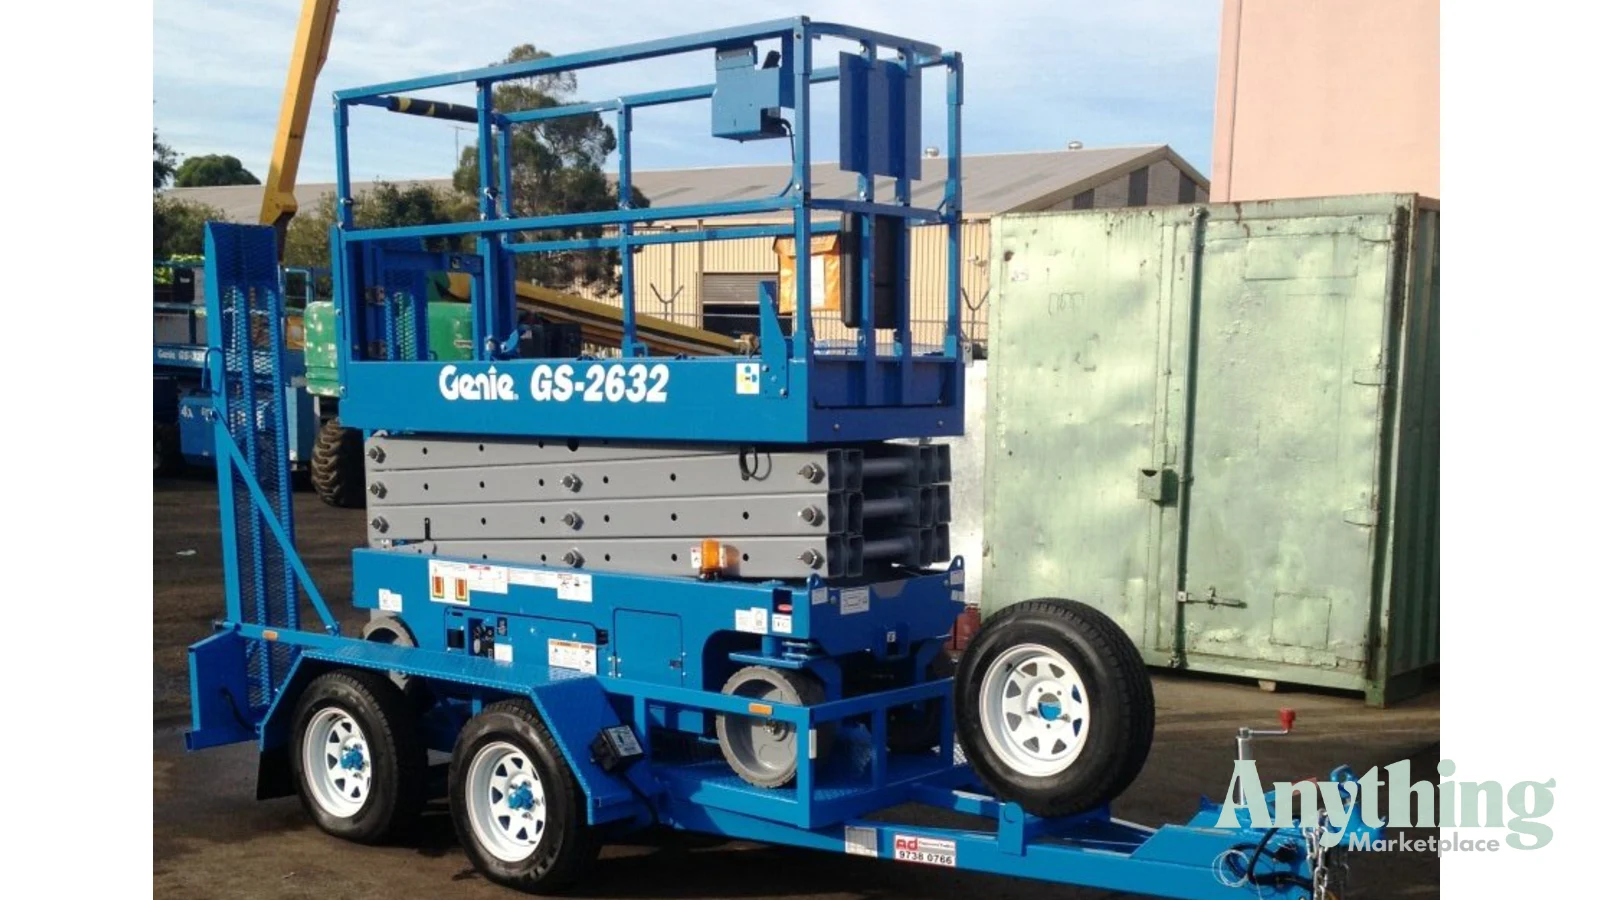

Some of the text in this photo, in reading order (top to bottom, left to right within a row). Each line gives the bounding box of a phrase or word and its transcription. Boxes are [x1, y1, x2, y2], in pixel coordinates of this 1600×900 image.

[438, 363, 670, 403] Genie GS-2632
[899, 850, 953, 864] 9738 0766
